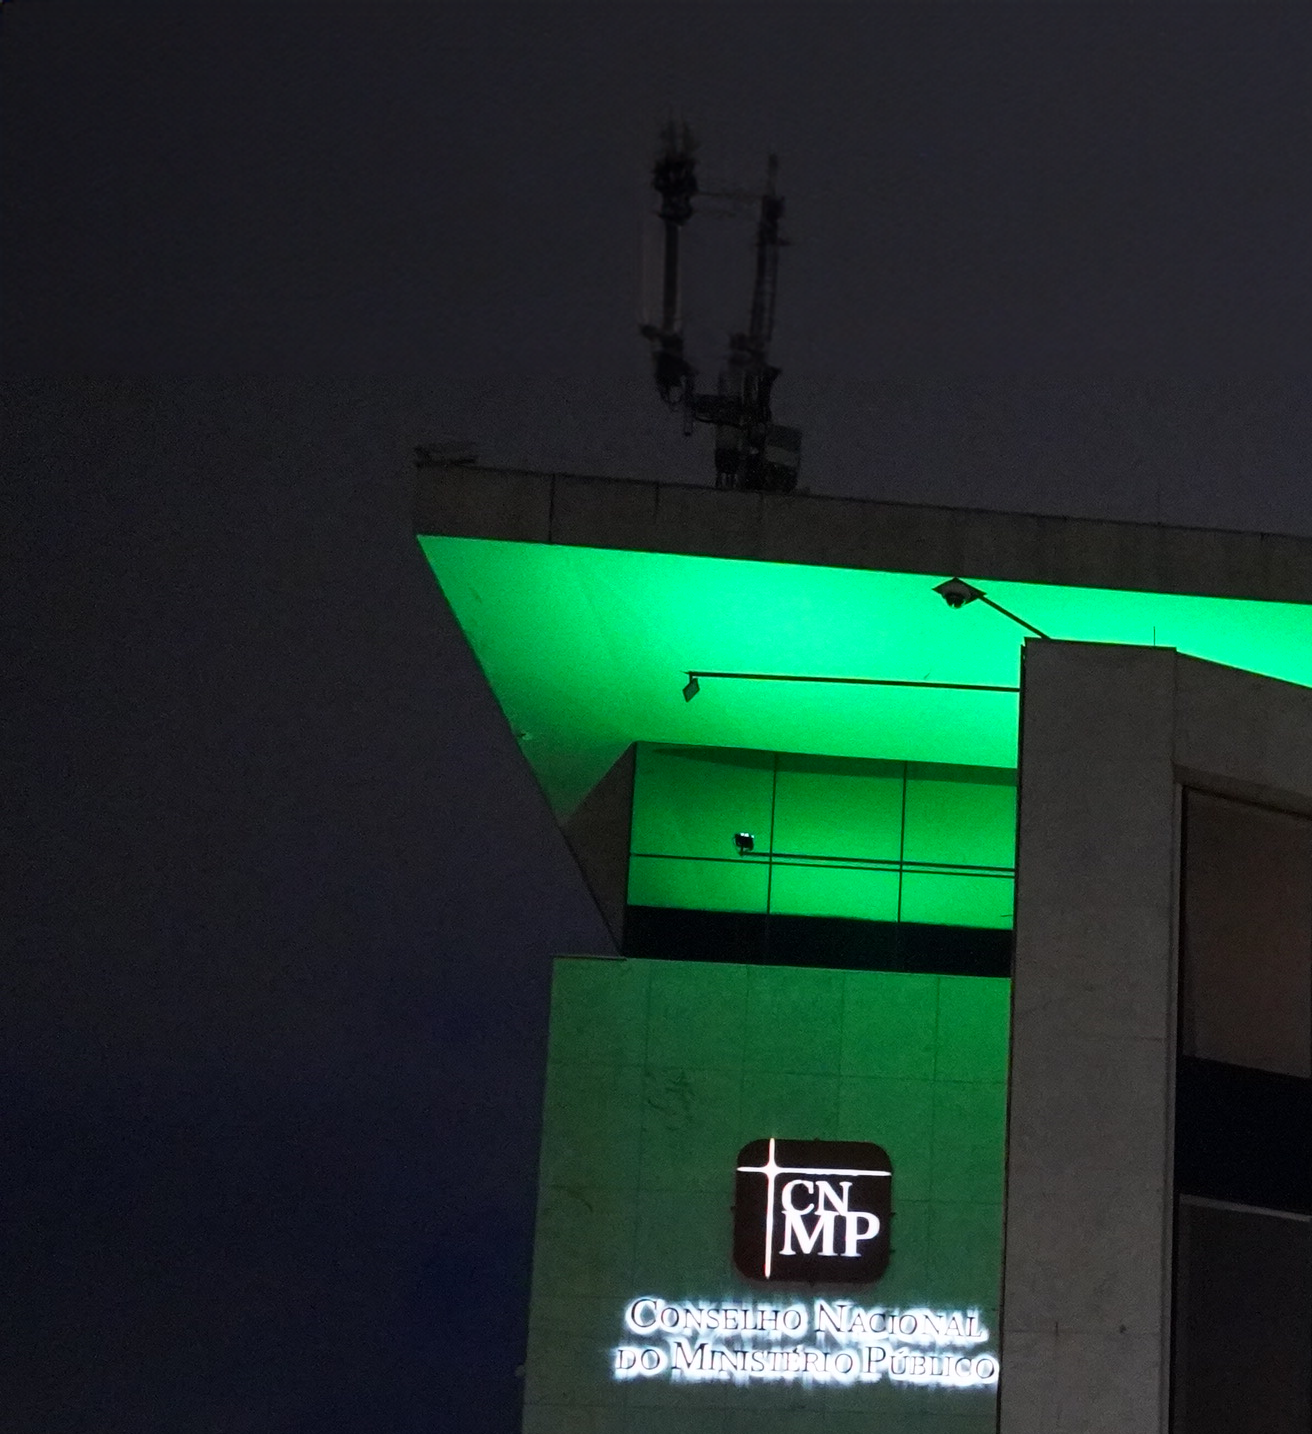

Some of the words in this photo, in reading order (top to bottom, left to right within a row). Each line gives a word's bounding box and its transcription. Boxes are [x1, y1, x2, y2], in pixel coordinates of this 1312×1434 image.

[781, 1179, 853, 1216] CN
[779, 1210, 880, 1258] MP
[630, 1297, 803, 1332] CONSELHO
[814, 1302, 983, 1338] NACIONAL
